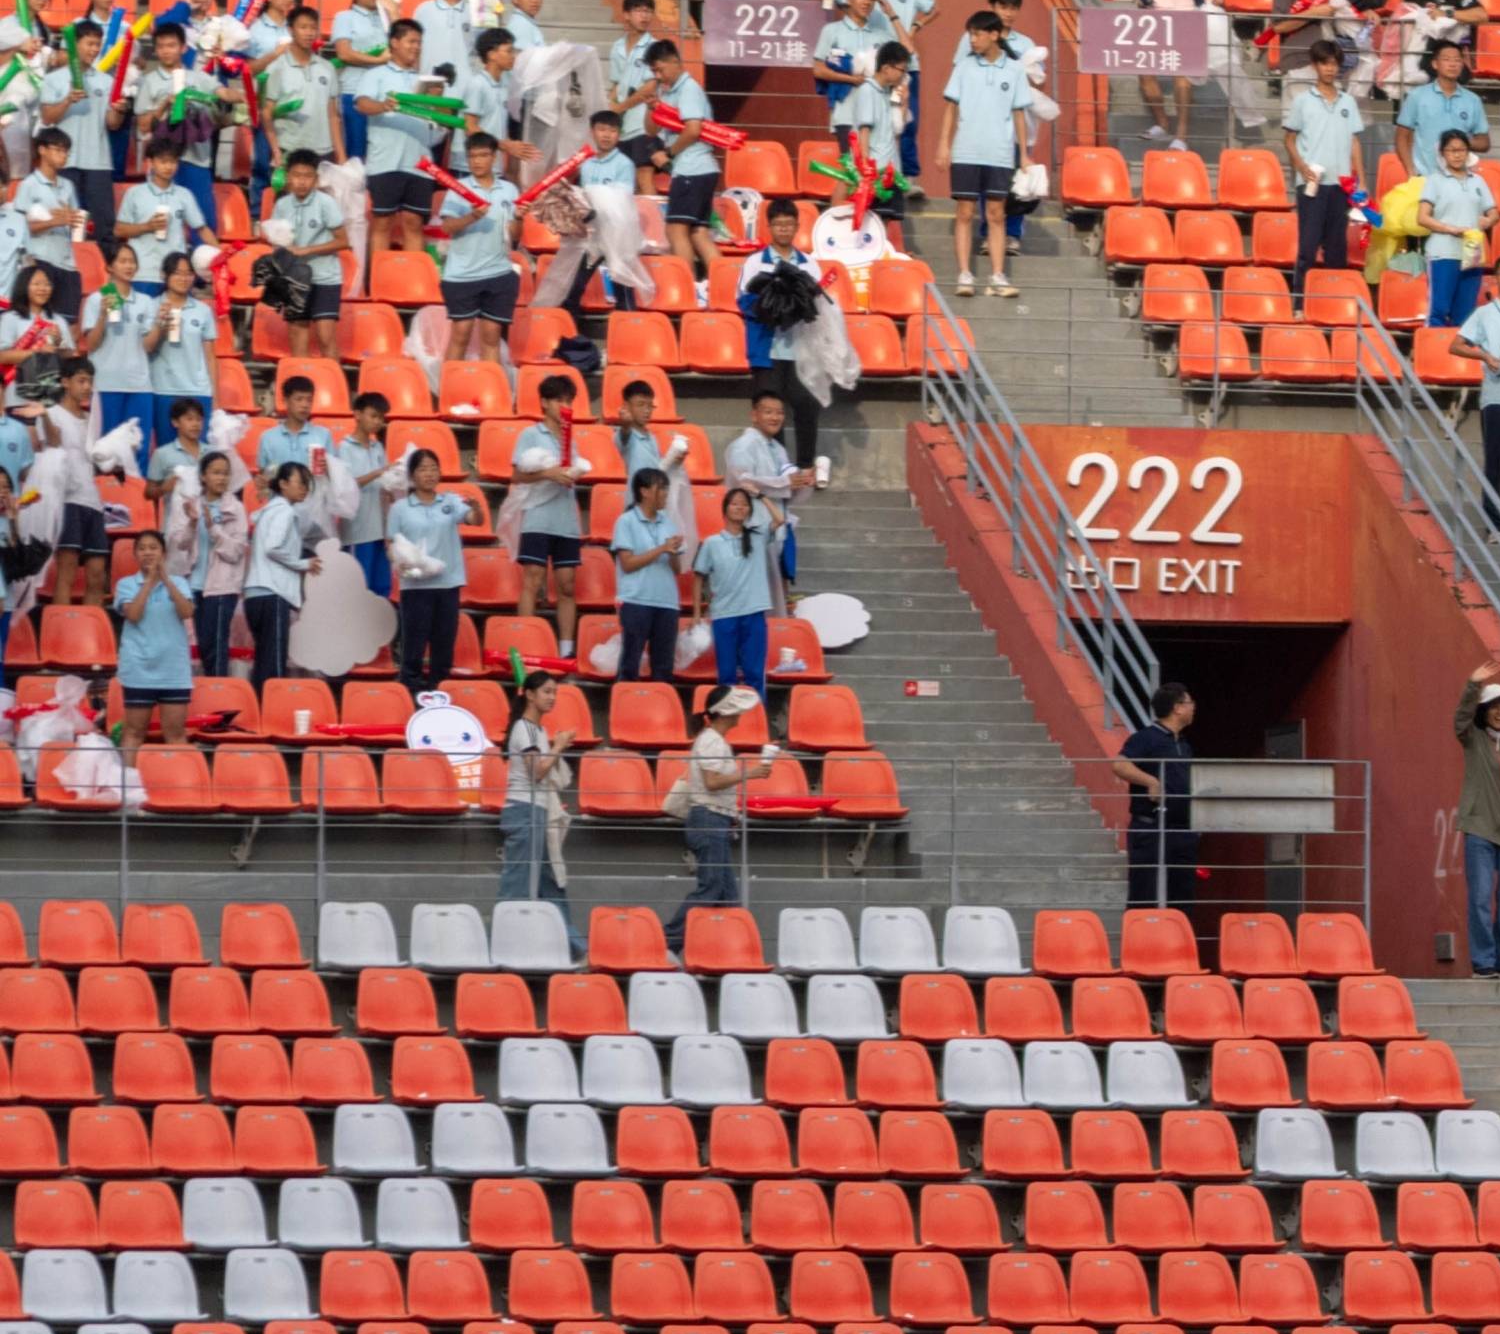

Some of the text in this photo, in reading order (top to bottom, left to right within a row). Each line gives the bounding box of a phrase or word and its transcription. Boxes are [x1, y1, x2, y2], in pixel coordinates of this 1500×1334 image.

[735, 4, 800, 39] 222
[1114, 14, 1175, 49] 221
[1102, 49, 1182, 72] 11-21排
[1066, 452, 1244, 545] 222
[1157, 558, 1242, 595] EXIT
